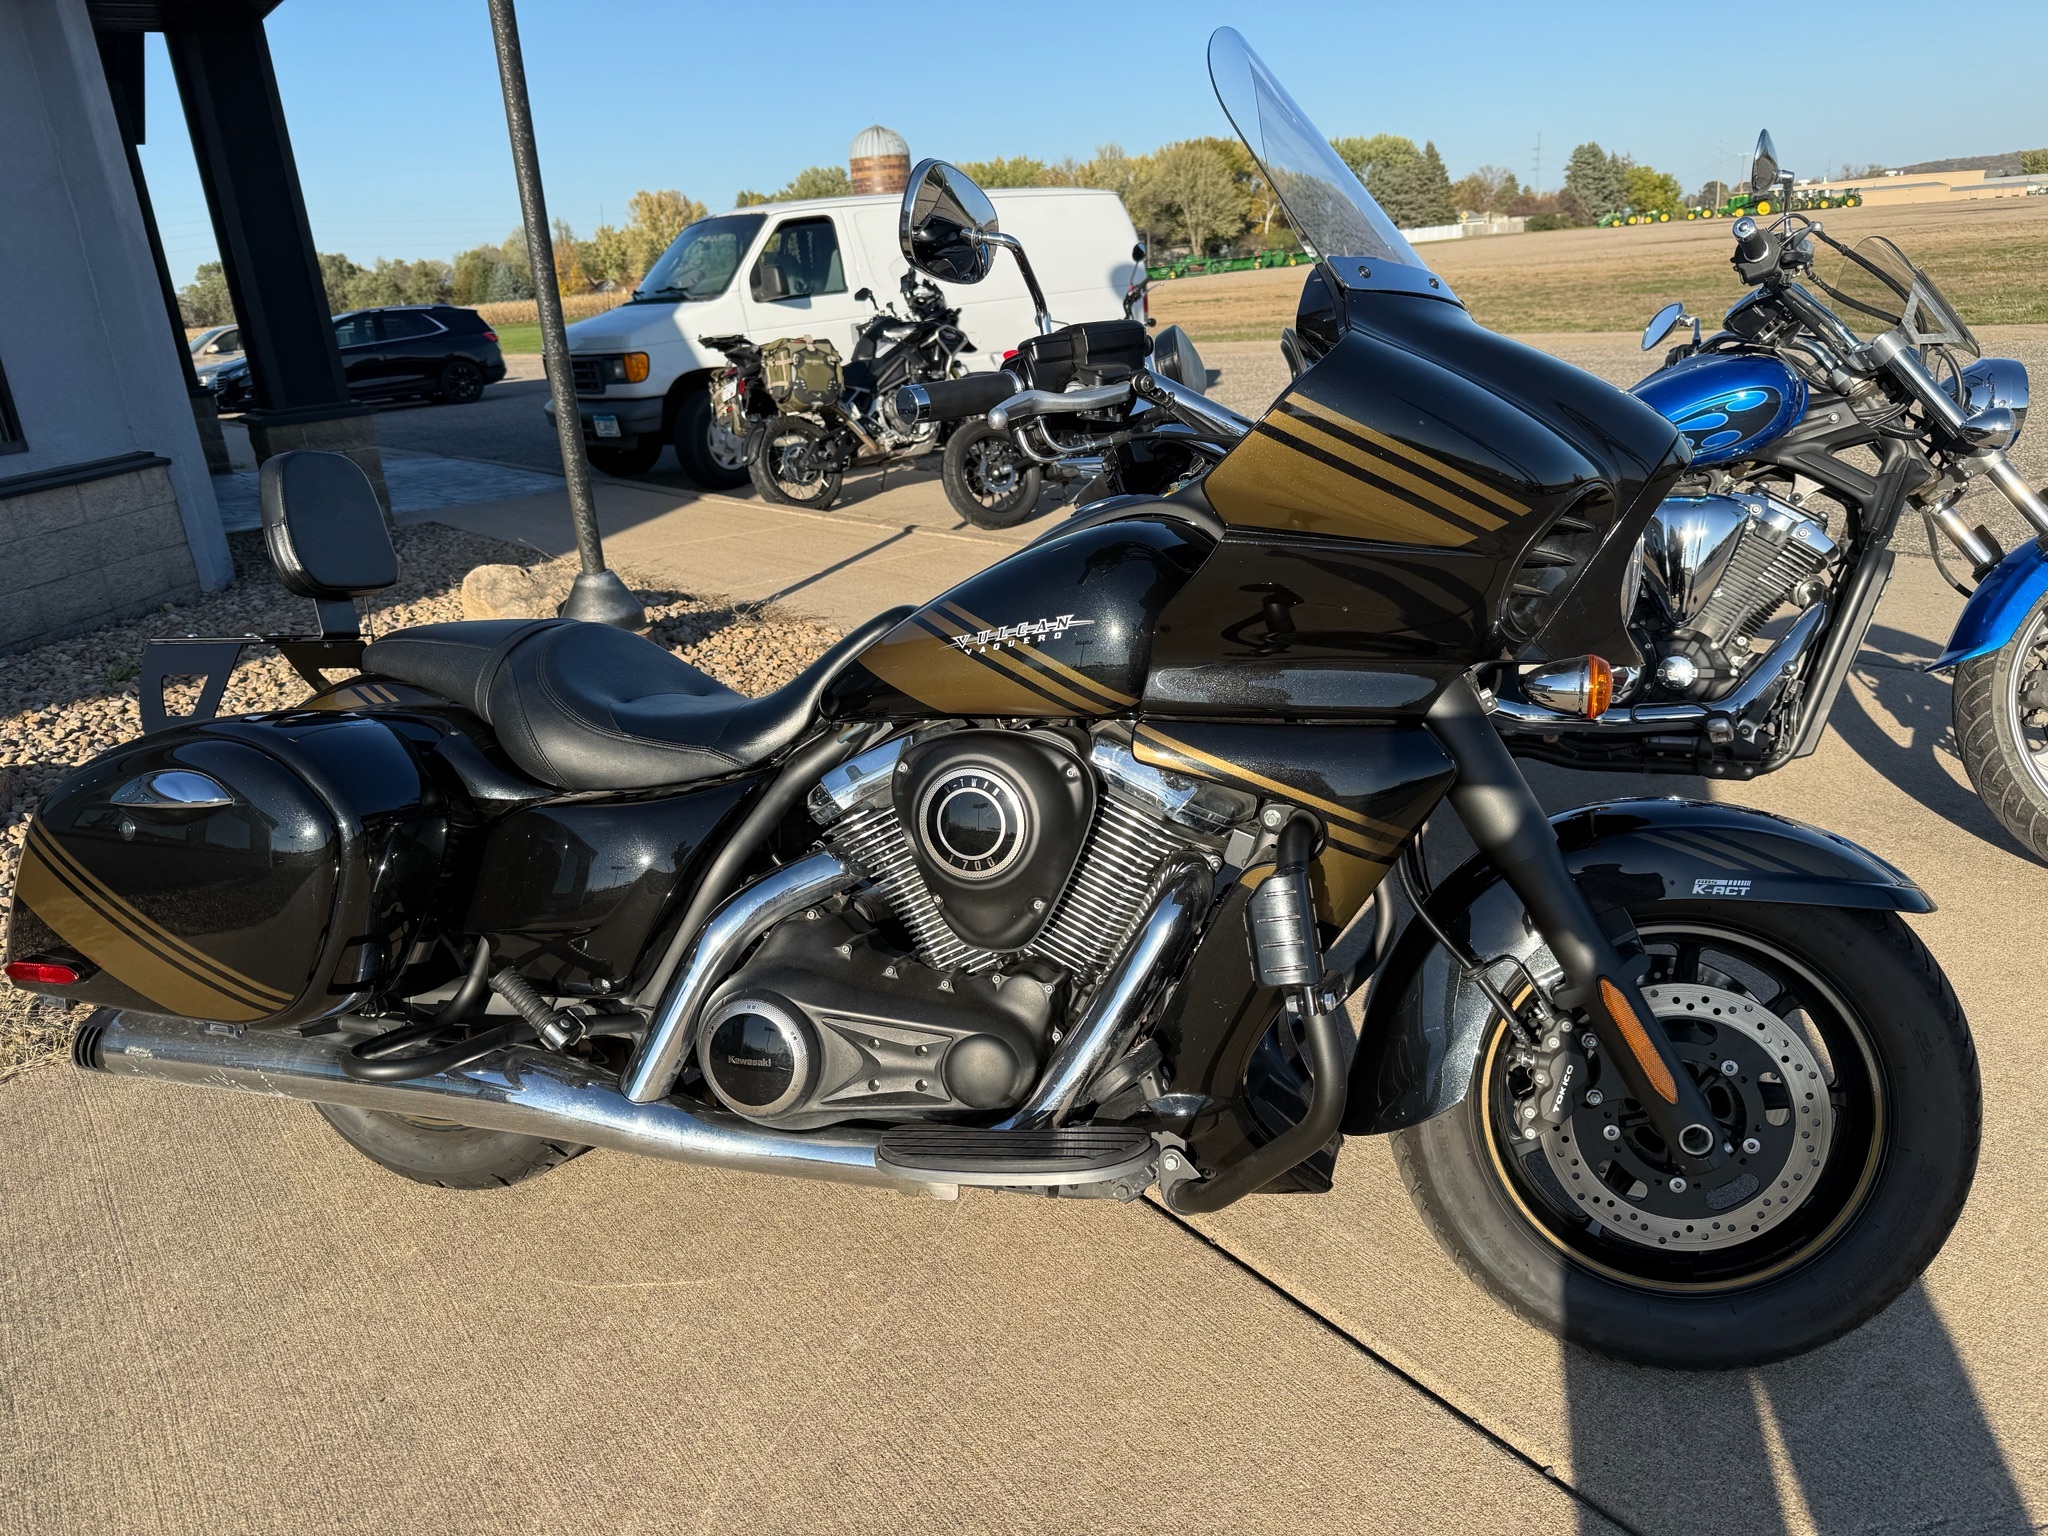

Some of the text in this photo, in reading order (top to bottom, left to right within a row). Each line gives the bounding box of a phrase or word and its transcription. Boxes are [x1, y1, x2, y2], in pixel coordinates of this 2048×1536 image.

[951, 613, 1075, 649] VULCAN
[964, 632, 1063, 656] VAQUERO
[948, 854, 996, 872] 1700
[1692, 884, 1751, 896] K-ACT
[728, 1055, 772, 1068] Kawasaki
[1552, 1064, 1574, 1113] TOKICO
